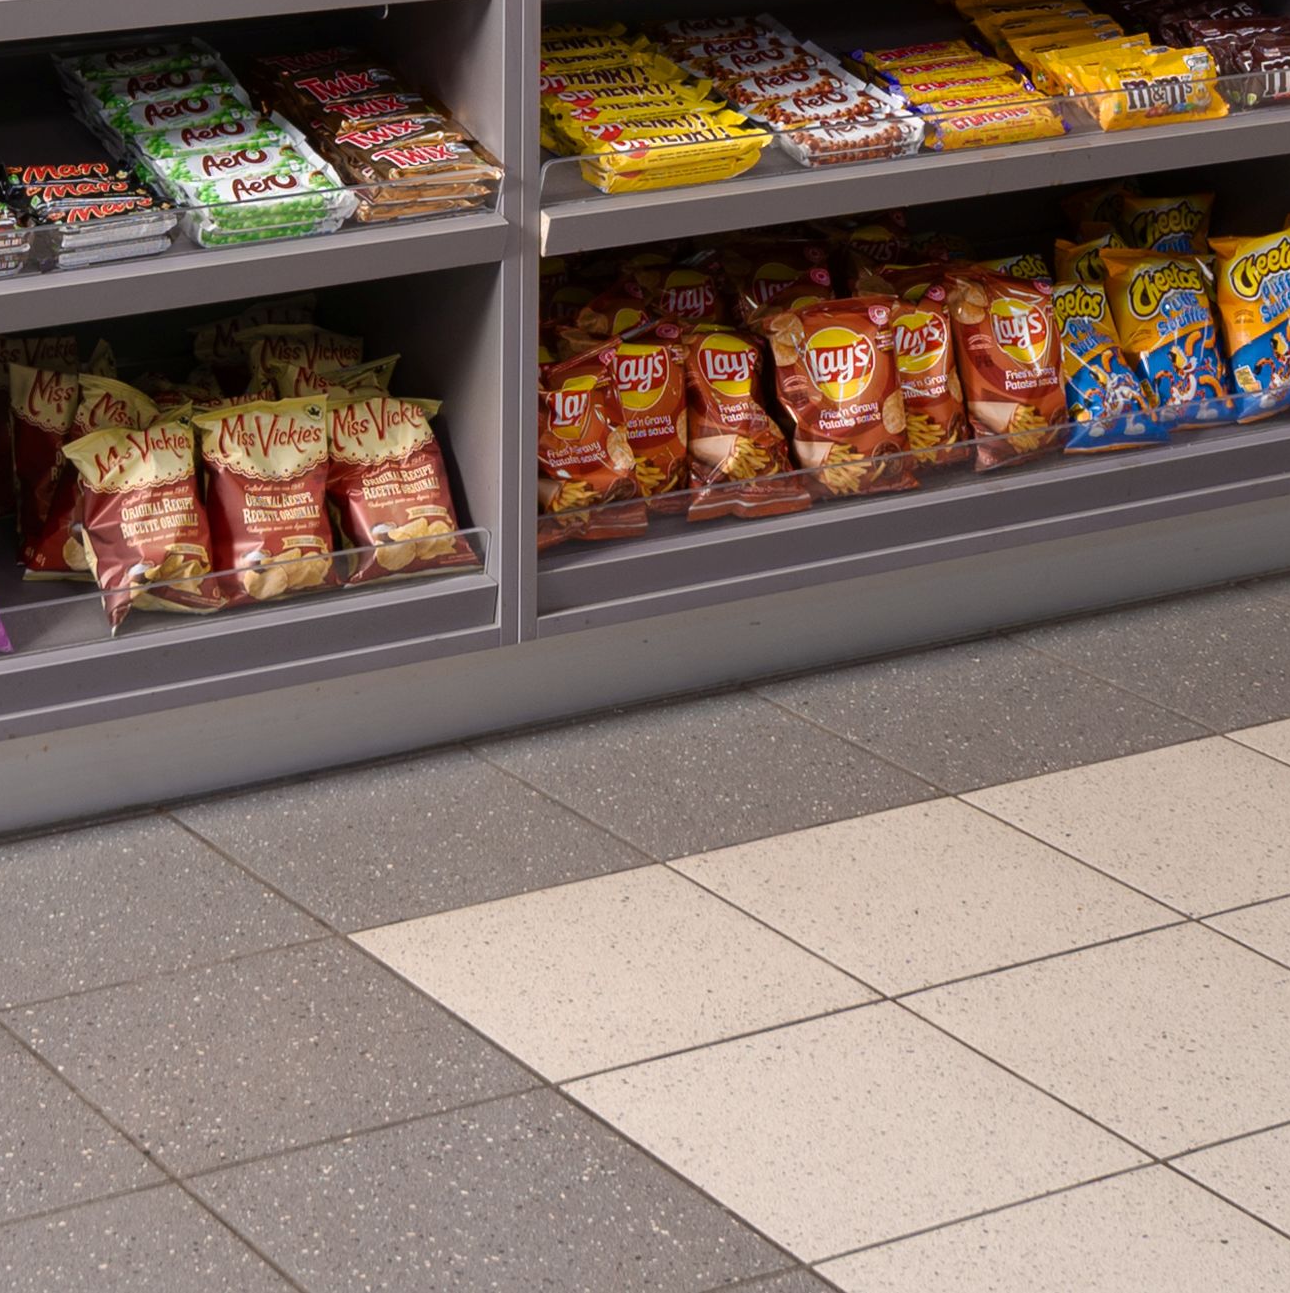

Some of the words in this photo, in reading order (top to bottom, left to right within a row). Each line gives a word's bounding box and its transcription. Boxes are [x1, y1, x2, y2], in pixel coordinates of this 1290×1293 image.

[294, 69, 379, 103] Twix
[566, 66, 650, 85] HENRY!
[595, 83, 678, 98] HENRY!
[792, 90, 848, 113] Aero
[1121, 74, 1193, 112] m&m's
[144, 96, 209, 126] Aero
[323, 94, 409, 120] Twix
[181, 119, 246, 147] Aero
[334, 119, 425, 149] Twix
[623, 113, 708, 129] HENRY!
[202, 147, 268, 177] Aero
[371, 143, 459, 169] Twix
[23, 162, 109, 184] Mars
[43, 180, 129, 202] Mars
[232, 172, 298, 202] Aero
[67, 196, 154, 224] Mars
[1131, 199, 1205, 250] Cheetos
[1128, 260, 1205, 321] Cheetos
[1160, 292, 1199, 318] Puffs
[993, 312, 1045, 349] Lay's
[705, 347, 756, 383] Lay's
[807, 341, 870, 383] Lay's
[28, 369, 75, 416] Miss
[1005, 378, 1037, 391] Patates
[644, 414, 672, 427] Gravy
[819, 417, 856, 430] Patates
[856, 411, 883, 423] sauce
[820, 406, 848, 420] Fries'n
[849, 401, 880, 415] Gravy
[218, 413, 256, 458] Miss
[254, 414, 324, 458] Vickie's
[331, 402, 369, 452] Miss
[365, 397, 425, 440] Vickie
[647, 424, 675, 437] sauce
[126, 427, 191, 464] Vickie's
[580, 450, 606, 463] sauce
[400, 464, 435, 481] RECIPE
[245, 492, 283, 509] ORIGINAL
[282, 490, 313, 507] RECIPE
[362, 484, 400, 500] RECETTE
[120, 503, 163, 521] ORIGINAL
[163, 496, 194, 514] RECIPE
[243, 507, 281, 524] RECETTE
[280, 504, 320, 521] ORIGINALE
[120, 518, 160, 539] RECETTE
[160, 512, 199, 533] ORIGINALE
